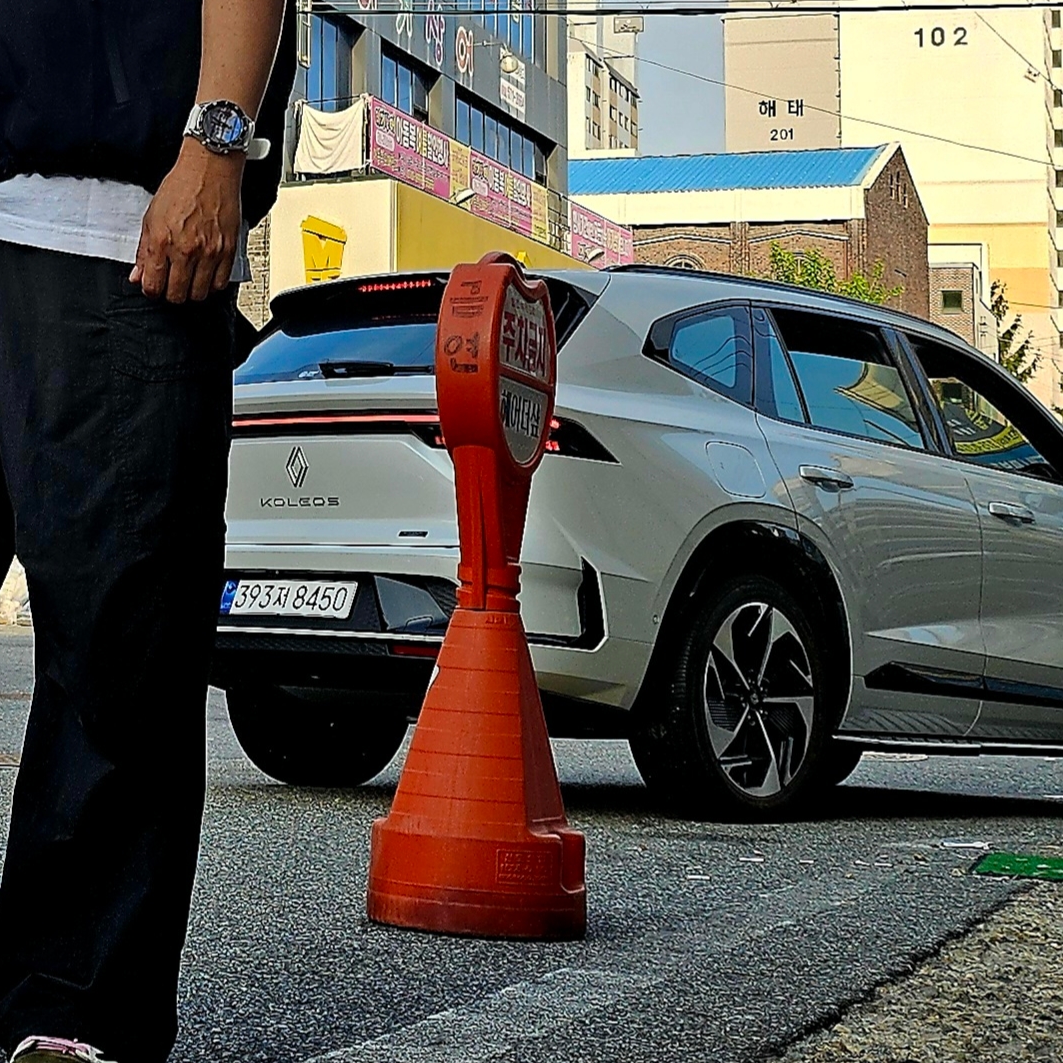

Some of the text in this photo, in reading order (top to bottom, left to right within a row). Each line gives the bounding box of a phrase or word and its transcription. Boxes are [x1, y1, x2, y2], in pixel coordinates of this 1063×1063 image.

[914, 26, 968, 48] 102
[770, 128, 794, 141] 201
[260, 496, 340, 508] KOLEOS
[292, 585, 349, 613] 8450
